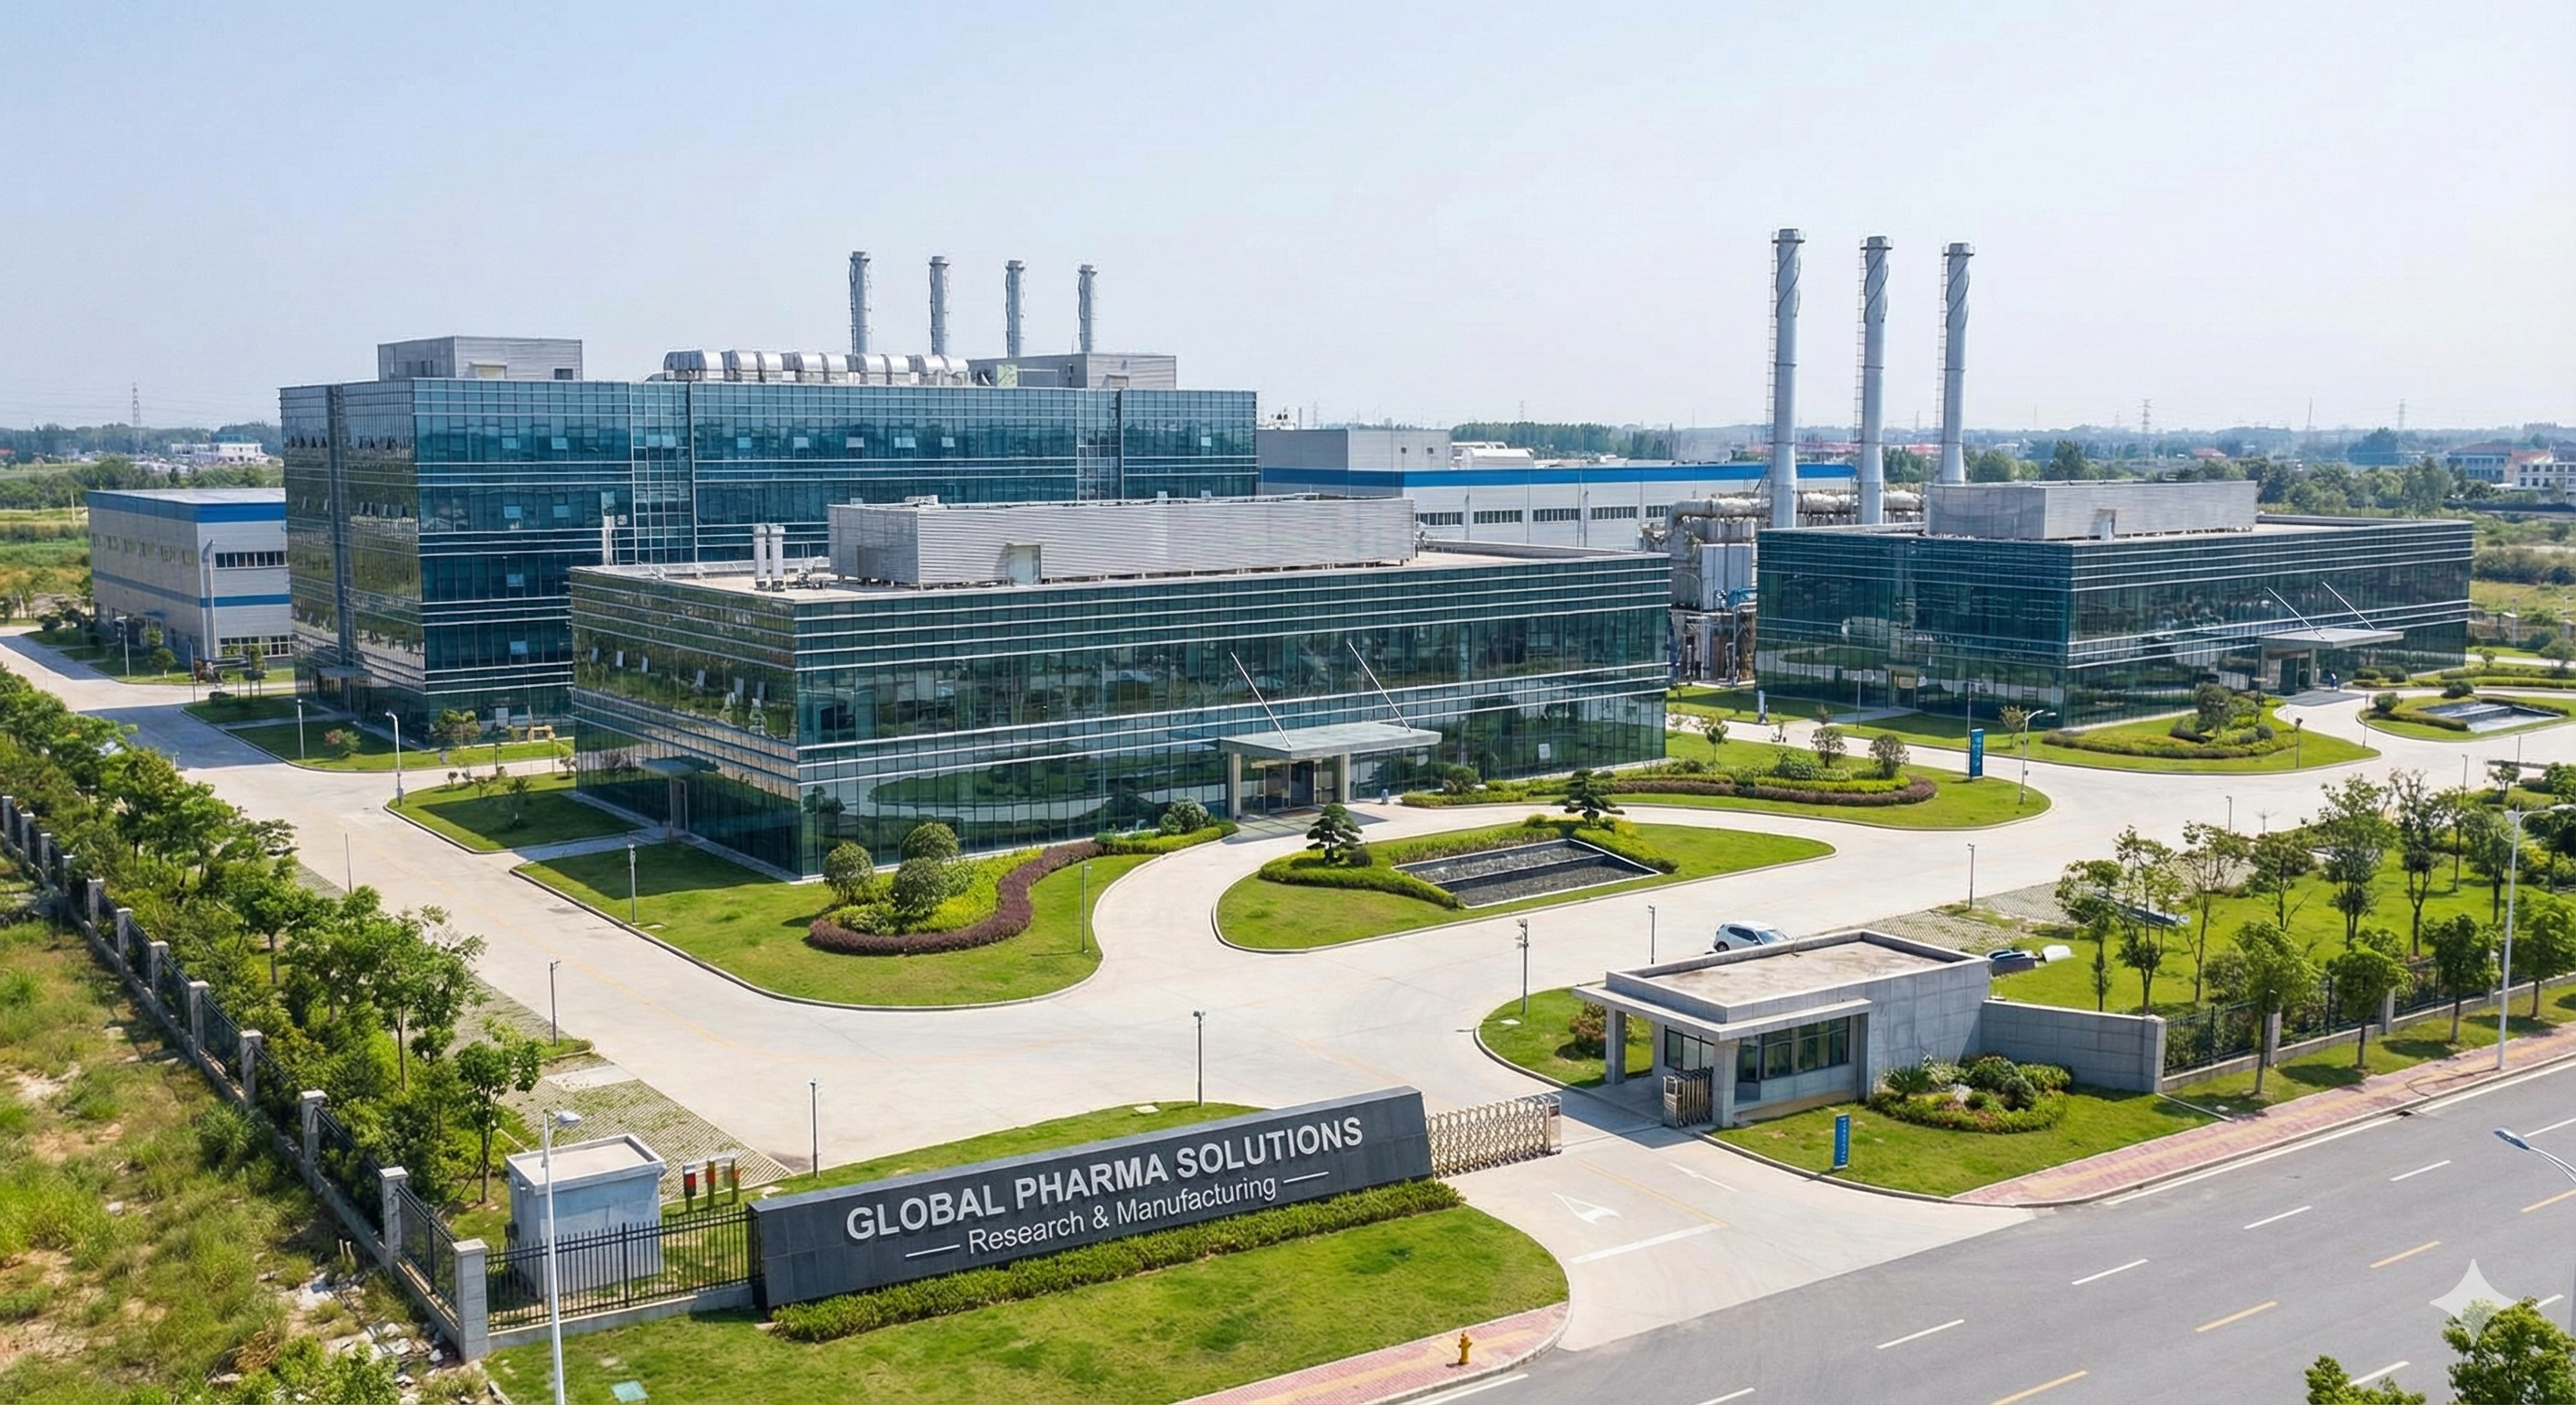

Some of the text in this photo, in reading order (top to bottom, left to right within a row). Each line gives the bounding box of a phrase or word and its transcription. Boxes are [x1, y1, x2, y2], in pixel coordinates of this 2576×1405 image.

[846, 1116, 1363, 1239] GLOBAL PHARMA SOLUTIONS
[968, 1177, 1276, 1254] Research & Manufacturing
